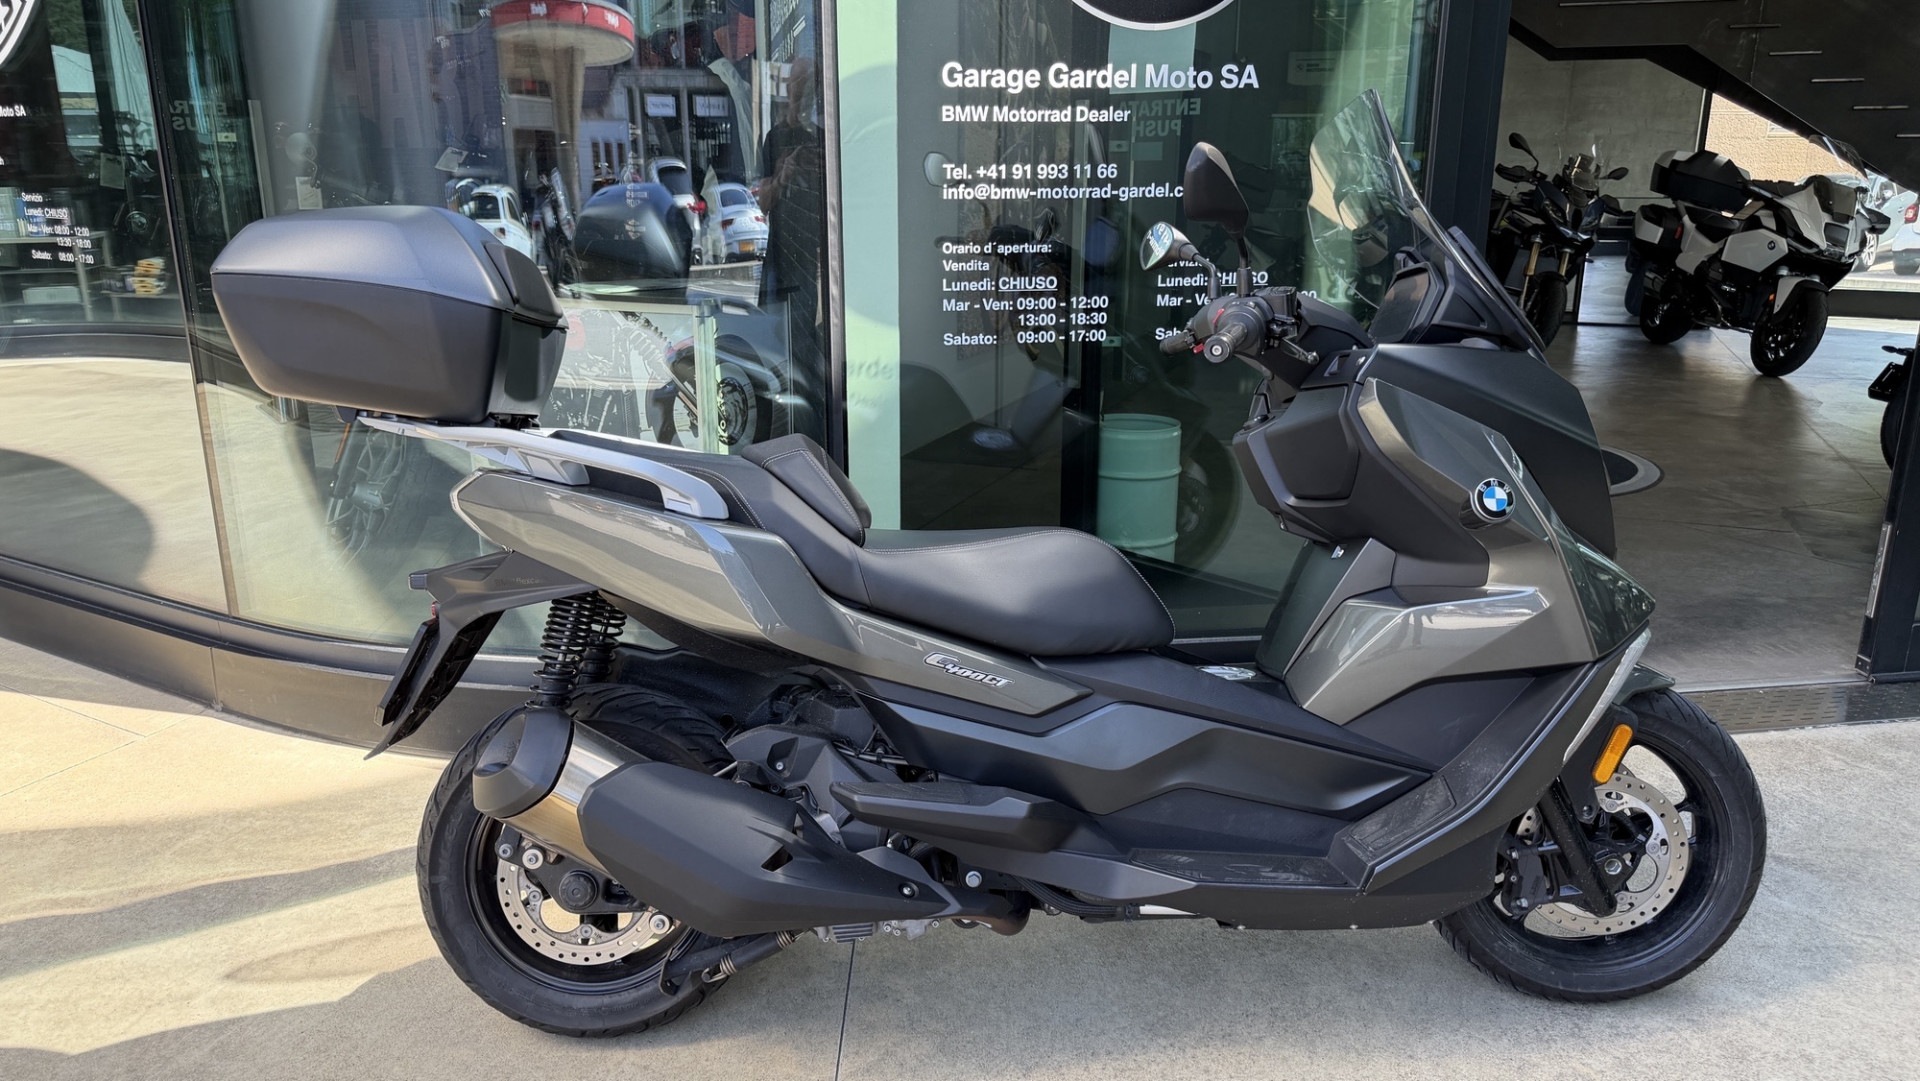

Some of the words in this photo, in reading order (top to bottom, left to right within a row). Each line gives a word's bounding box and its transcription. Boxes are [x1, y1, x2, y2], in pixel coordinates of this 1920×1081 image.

[941, 61, 1041, 94] Garage
[1048, 62, 1137, 89] Gardel
[1145, 63, 1213, 89] Moto
[1220, 63, 1260, 89] SA
[14, 104, 26, 117] SA
[941, 105, 989, 122] BMW
[992, 105, 1072, 122] Motorrad
[1075, 105, 1131, 122] Dealer
[942, 163, 972, 179] Tel.
[976, 163, 1006, 179] +41
[1012, 163, 1031, 179] 91
[1037, 163, 1068, 179] 993
[1073, 163, 1091, 179] 11
[1096, 163, 1118, 179] 66
[942, 182, 1184, 201] info@bmw-motorrad-gardel.c
[44, 207, 68, 219] CHIUSO
[74, 227, 89, 236] 12:00
[942, 242, 981, 254] Orario
[79, 254, 94, 264] 17:00
[942, 260, 990, 271] Vendita
[942, 278, 996, 291] Lunedì:
[998, 276, 1058, 291] CHIUSO
[1157, 273, 1208, 287] Lunedì:
[942, 299, 970, 311] Mar
[982, 298, 1013, 311] Ven:
[1016, 297, 1056, 310] 09:00
[1070, 296, 1109, 308] 12:00
[1156, 294, 1183, 306] Mar
[1018, 313, 1056, 326] 13:00
[1070, 312, 1107, 325] 18:30
[943, 333, 998, 345] Sabato:
[1017, 331, 1055, 343] 09:00
[1069, 329, 1107, 342] 17:00
